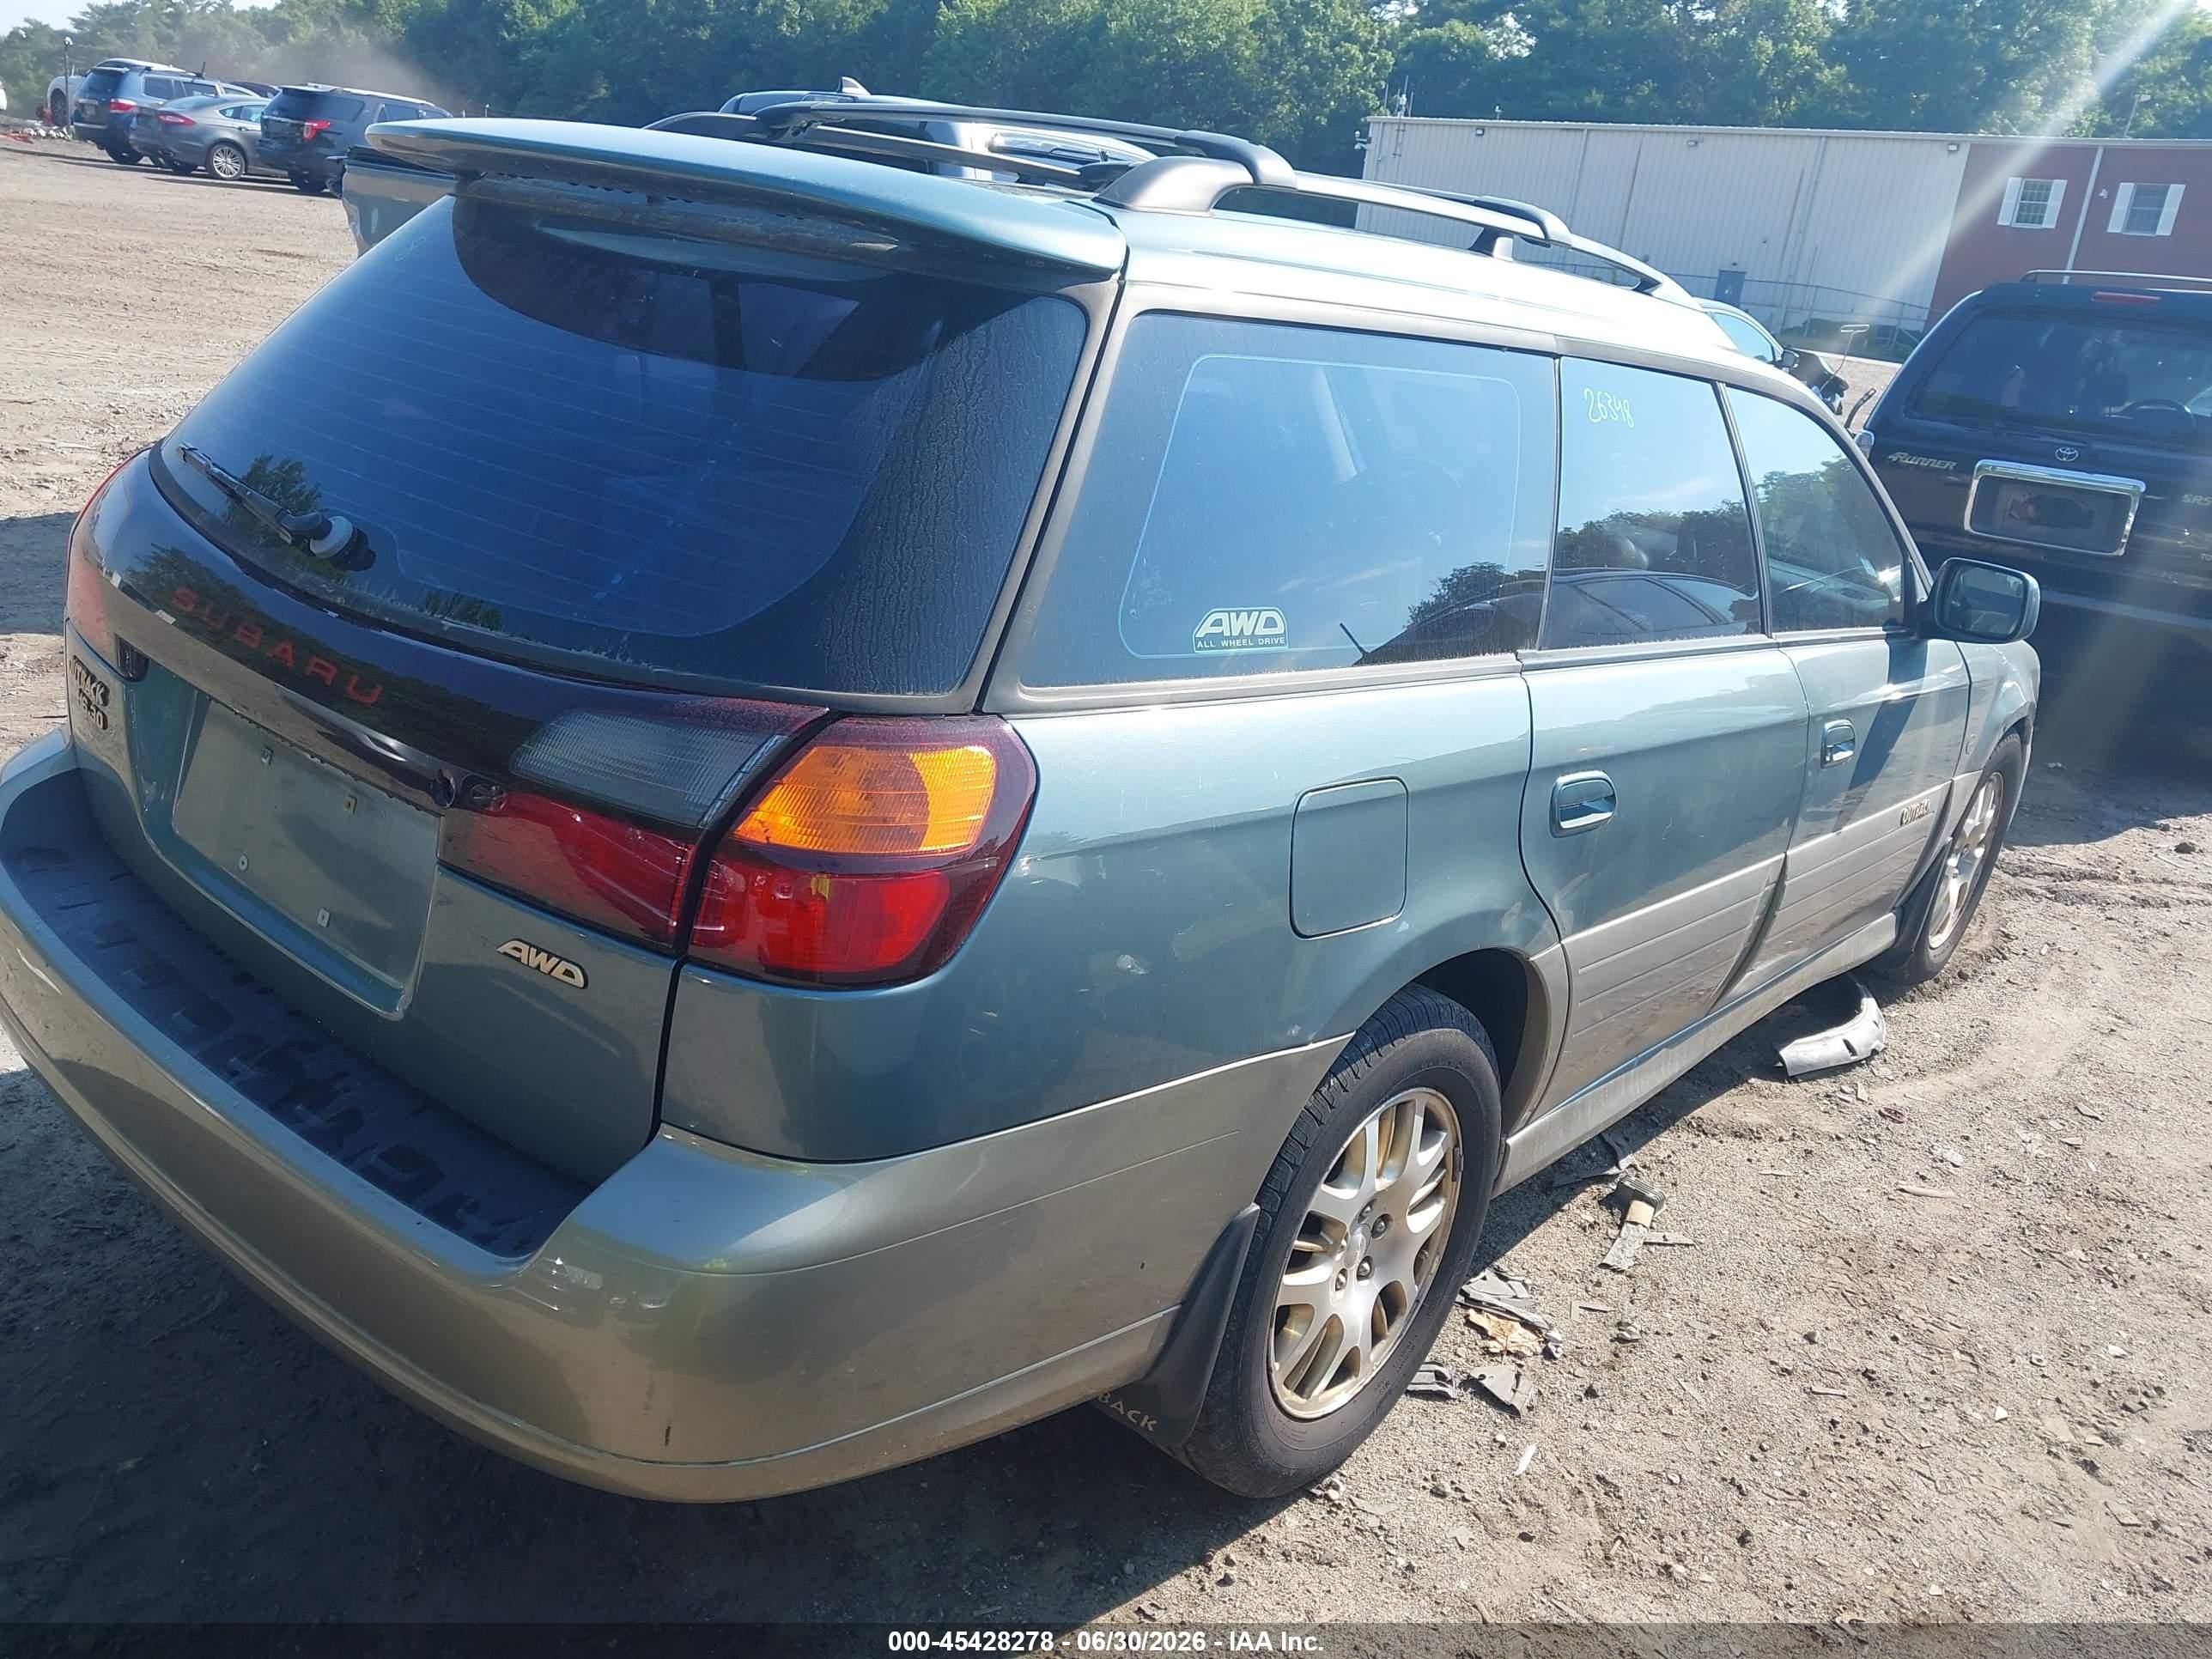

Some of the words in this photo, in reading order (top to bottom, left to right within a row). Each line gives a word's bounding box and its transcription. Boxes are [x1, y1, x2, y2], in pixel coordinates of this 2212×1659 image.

[1583, 387, 1635, 428] 26348
[1195, 611, 1285, 638] AWD
[1196, 640, 1216, 648] ALL
[1220, 639, 1254, 647] WHEEL
[1258, 636, 1285, 646] DRIVE
[172, 586, 383, 705] SUBARU
[495, 938, 588, 989] AWD
